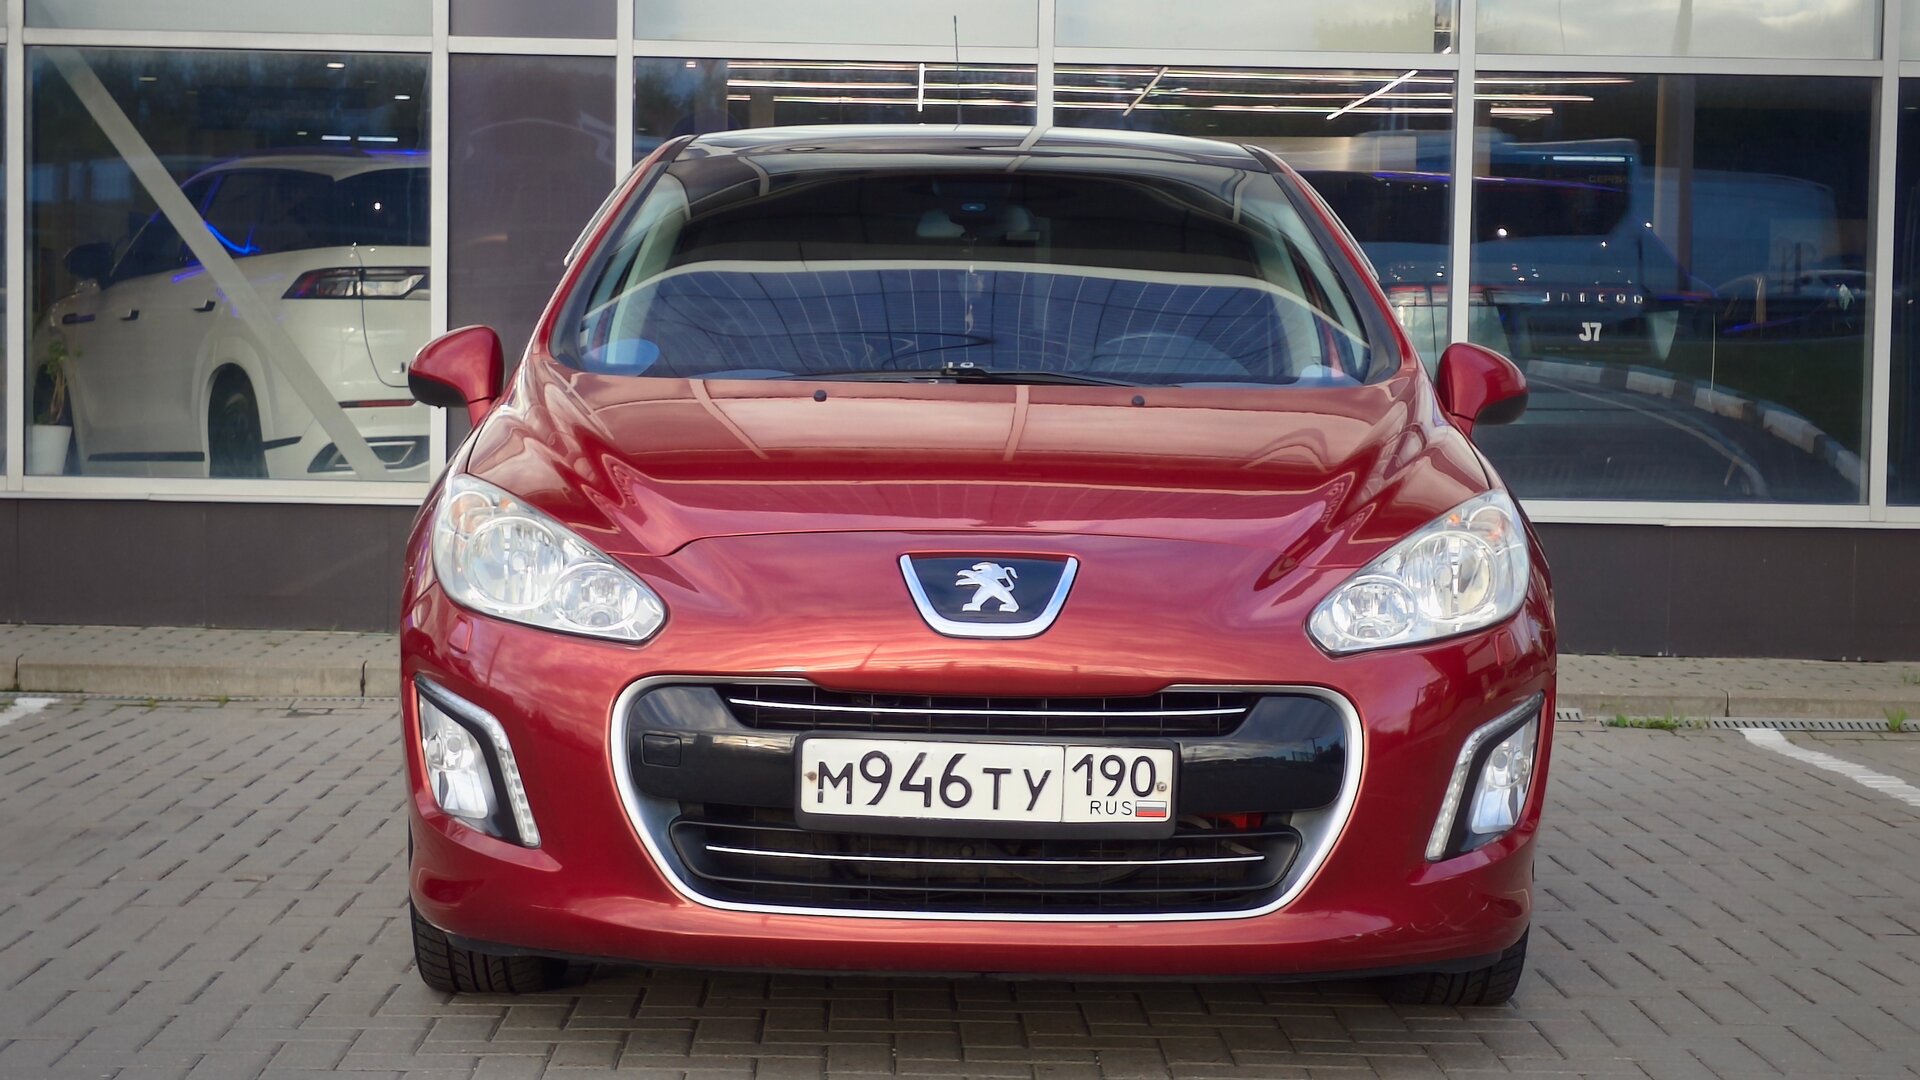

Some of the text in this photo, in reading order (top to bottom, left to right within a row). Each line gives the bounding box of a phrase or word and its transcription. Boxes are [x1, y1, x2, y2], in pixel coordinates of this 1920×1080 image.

[1578, 322, 1602, 342] J7
[1071, 753, 1156, 797] 190
[1089, 801, 1133, 816] RUS
